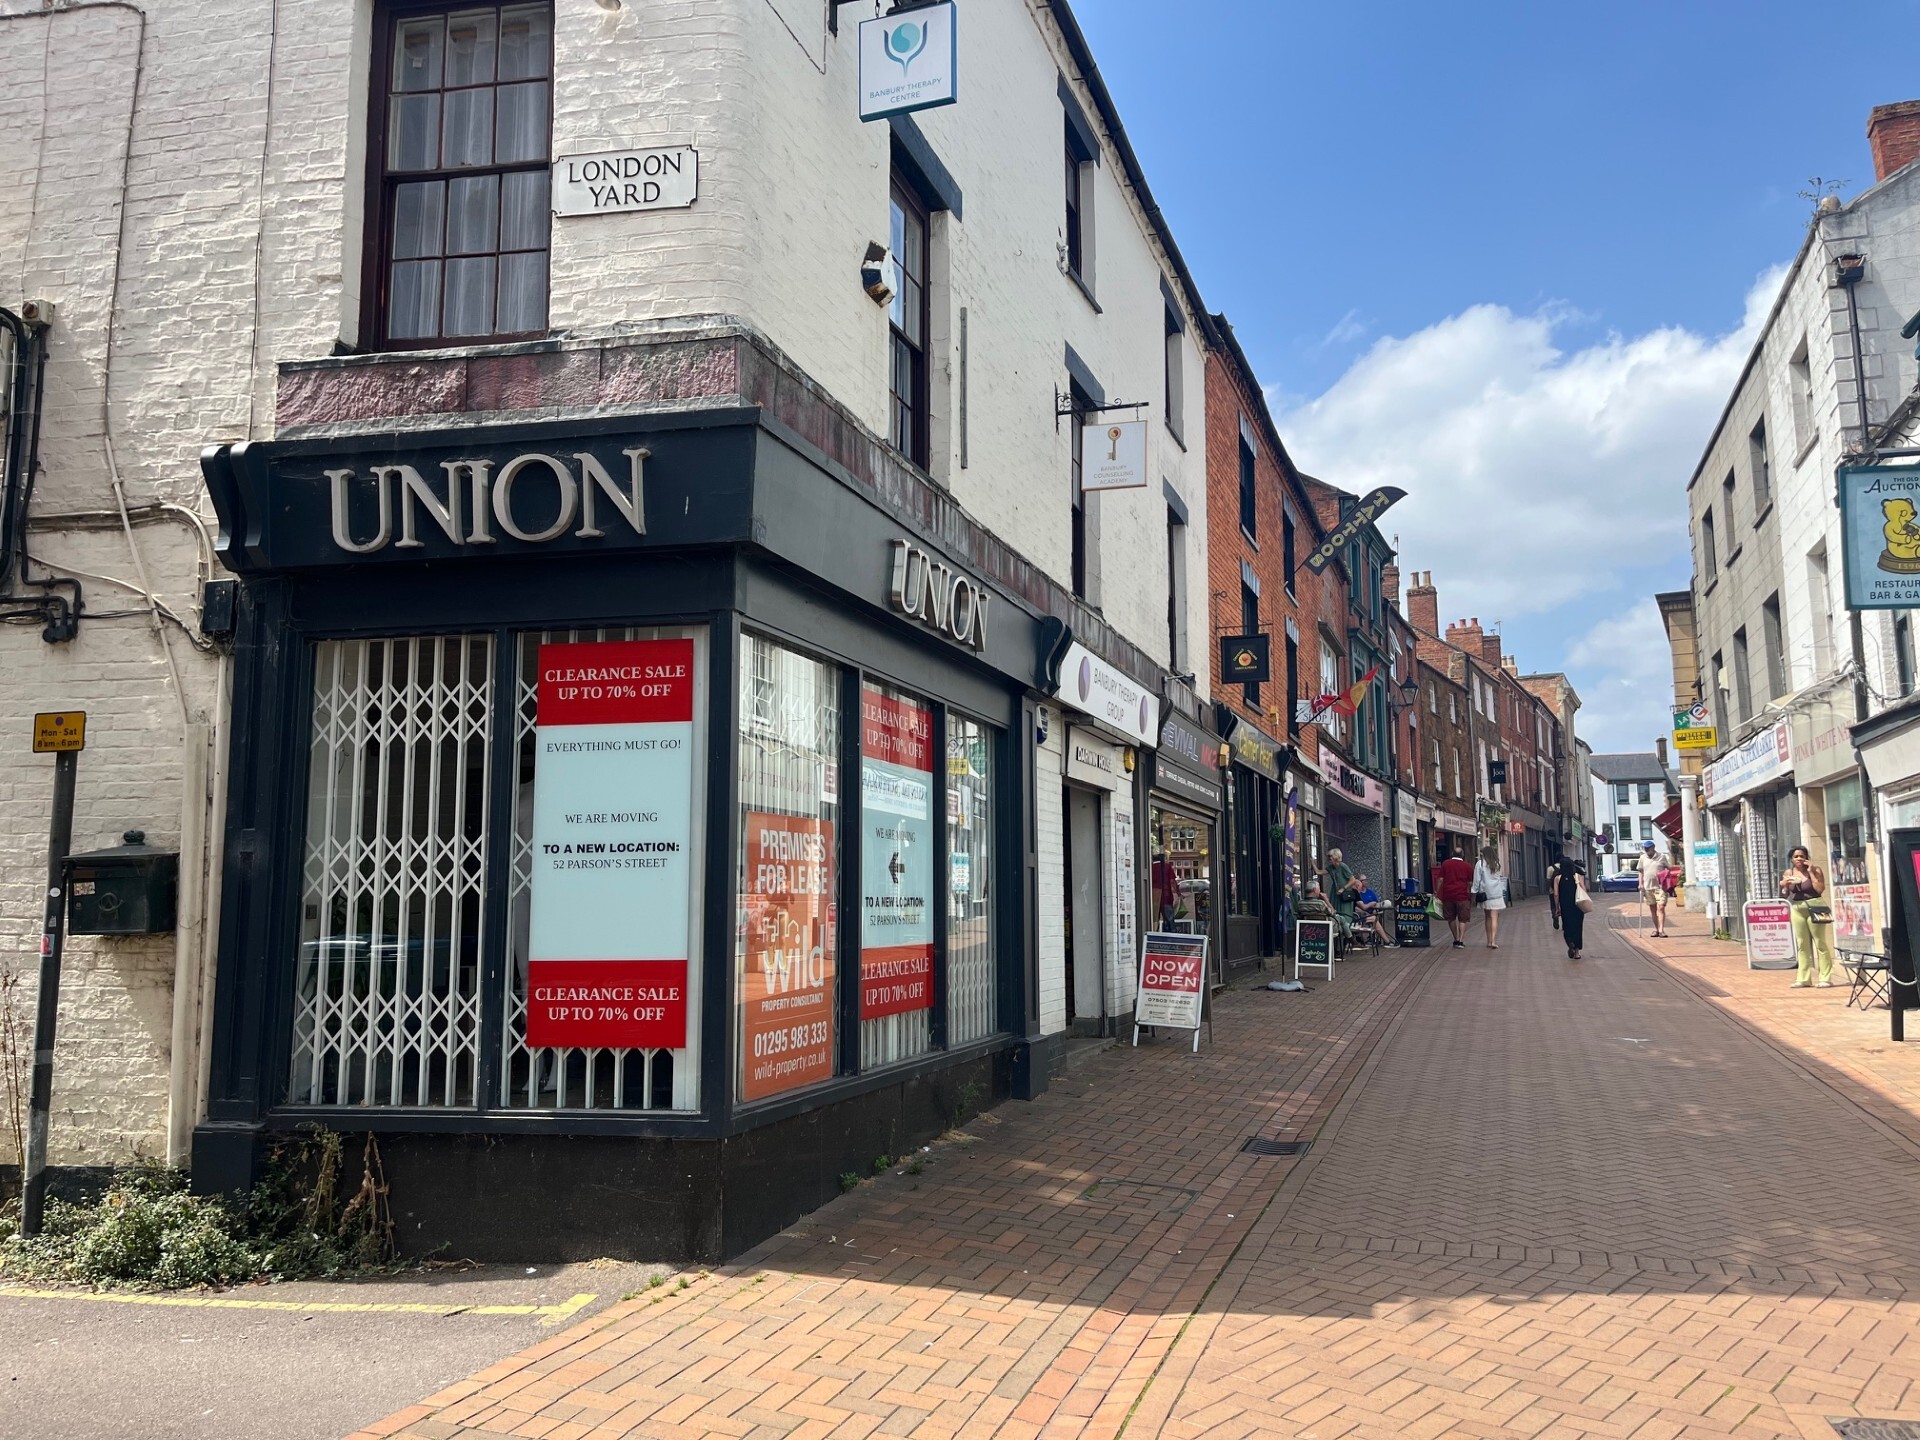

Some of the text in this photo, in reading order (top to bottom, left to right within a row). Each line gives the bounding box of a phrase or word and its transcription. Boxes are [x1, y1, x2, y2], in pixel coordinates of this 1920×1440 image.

[870, 77, 942, 99] BANBURY THERAPY
[890, 91, 920, 103] CENTRE
[568, 152, 681, 183] LONDON
[588, 181, 661, 207] YARD
[323, 448, 651, 553] UNION
[1309, 490, 1390, 568] TATTOOS
[892, 538, 991, 652] UNION
[1870, 591, 1890, 600] BAR
[1894, 590, 1902, 599] &
[544, 665, 686, 682] CLEARANCE SALE
[558, 684, 672, 700] UP TO 70% OFF
[1093, 667, 1138, 708] BANBURY THERAPY
[1106, 701, 1124, 723] GROUP
[41, 728, 57, 737] Mon
[63, 728, 77, 736] Sat
[547, 739, 681, 752] EVERYTHING MUST GO!
[867, 729, 878, 746] UP
[908, 742, 923, 759] OFF
[565, 812, 658, 823] WE ARE MOVING
[875, 827, 885, 840] WE
[885, 829, 895, 840] ARE
[543, 842, 680, 854] TO A NEW LOCATION:
[760, 829, 826, 862] PREMISES
[553, 858, 668, 869] 52 PARSON'S STREET
[757, 864, 828, 895] FOR LEASE
[865, 896, 874, 907] TO
[875, 896, 880, 907] A
[881, 896, 895, 907] NEW
[869, 915, 876, 926] 52
[762, 924, 825, 995] wild
[861, 957, 929, 981] CLEARANCE SALE
[1150, 960, 1195, 973] NOW
[1145, 973, 1197, 988] OPEN
[535, 987, 680, 1001] CLEARANCE SALE
[761, 992, 824, 1013] PROPERTY CONSULTANCY
[865, 981, 924, 1006] UP TO 70% OFF
[548, 1007, 665, 1020] UP TO 70% OFF
[754, 1020, 827, 1058] 01295 983 333
[754, 1047, 826, 1081] wild-property.co.uk
